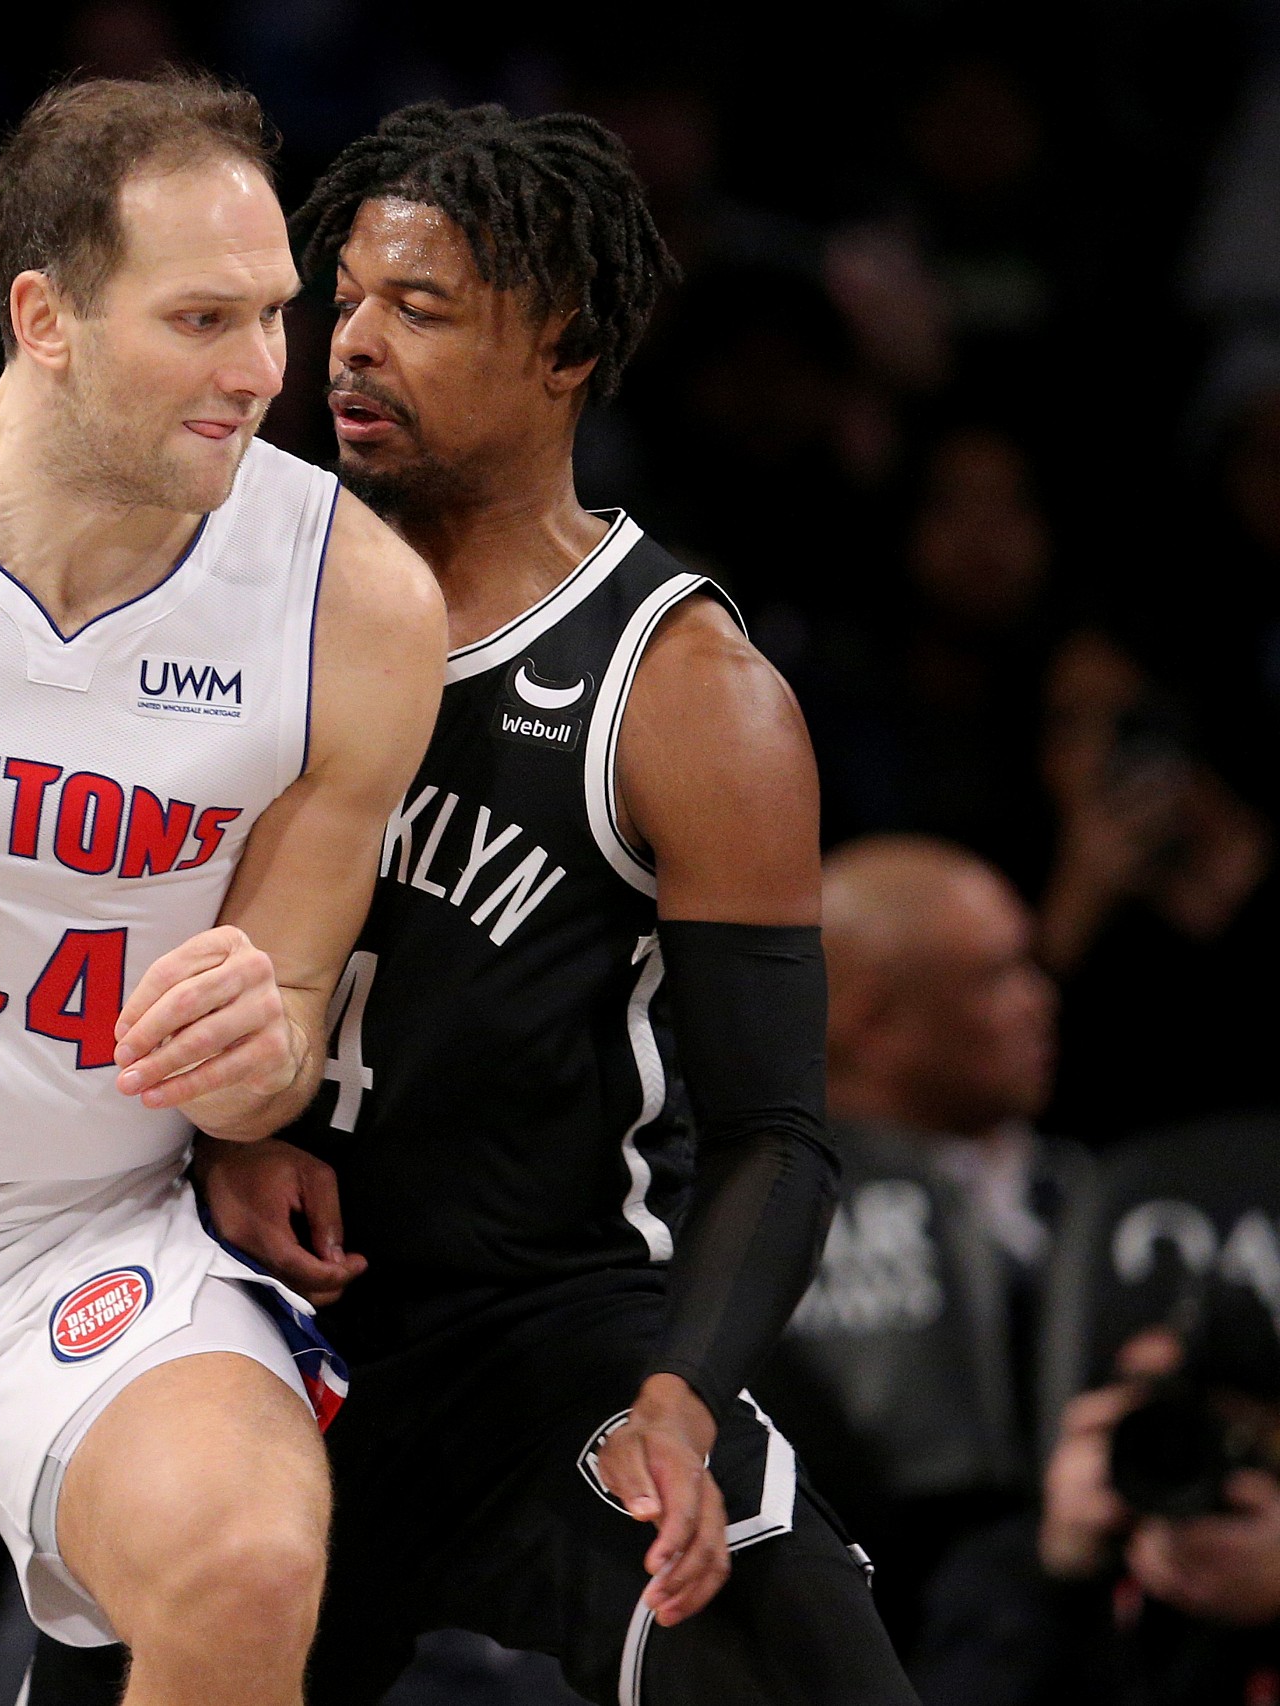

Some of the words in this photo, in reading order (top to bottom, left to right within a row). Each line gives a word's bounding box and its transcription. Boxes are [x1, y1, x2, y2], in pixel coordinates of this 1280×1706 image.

[141, 660, 242, 704] UWM
[137, 701, 161, 710] UNITED
[162, 704, 202, 714] WHOLESALE
[203, 708, 241, 718] MORTGAGE
[501, 713, 571, 743] Webull
[65, 1282, 130, 1330] DETROIT
[67, 1294, 134, 1342] PISTONS
